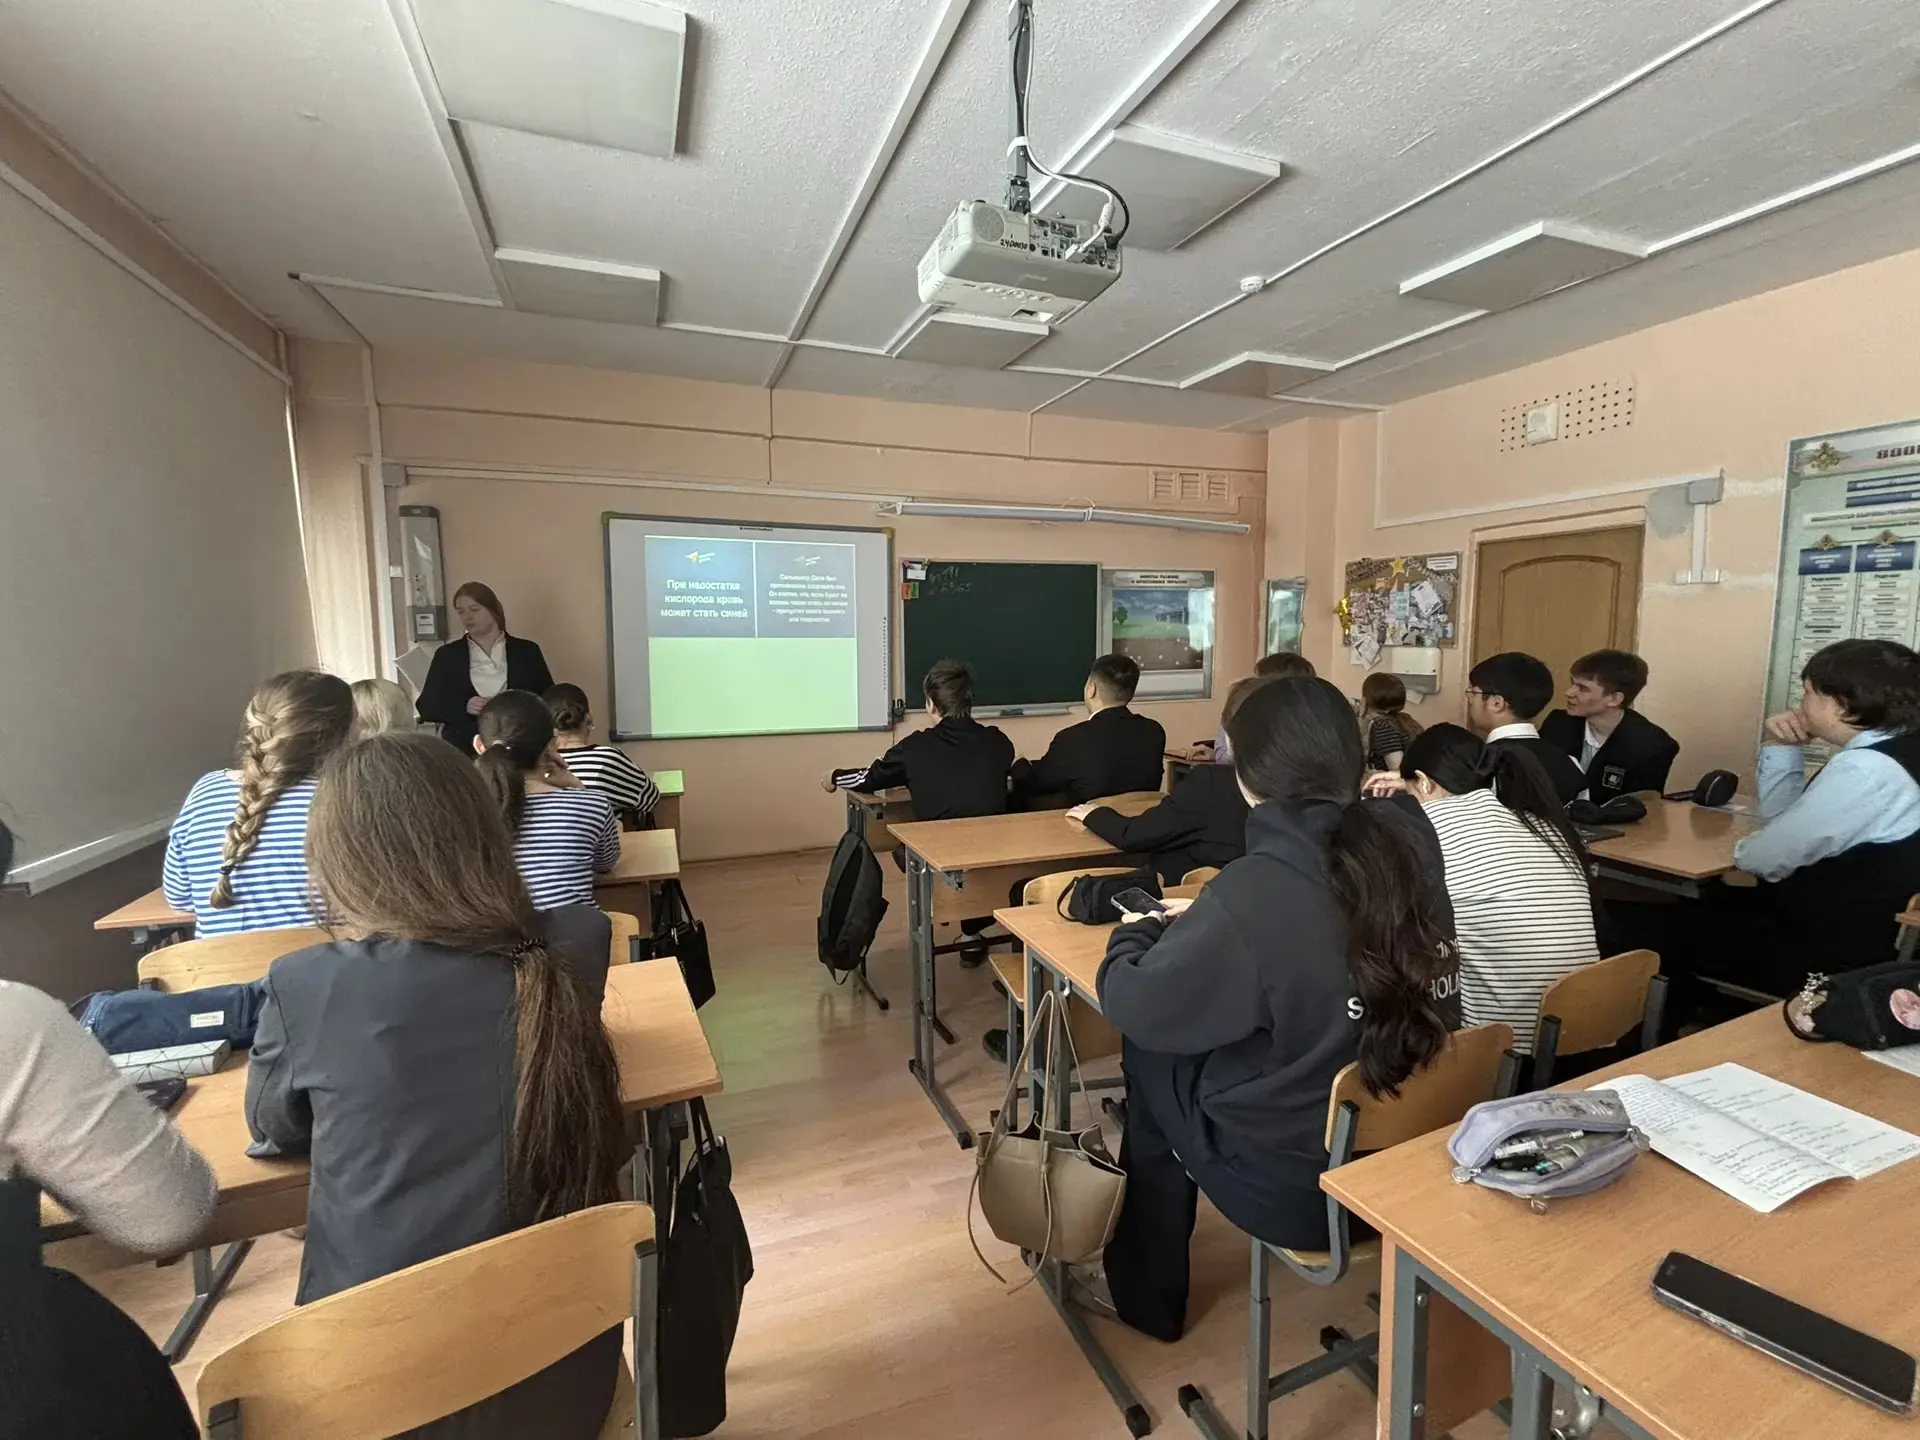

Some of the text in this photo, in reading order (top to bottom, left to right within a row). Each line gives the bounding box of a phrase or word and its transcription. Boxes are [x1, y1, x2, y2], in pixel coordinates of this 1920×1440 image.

[666, 579, 741, 591] При недостатке
[664, 595, 744, 605] кислорода кровь
[660, 608, 748, 618] может стать синей
